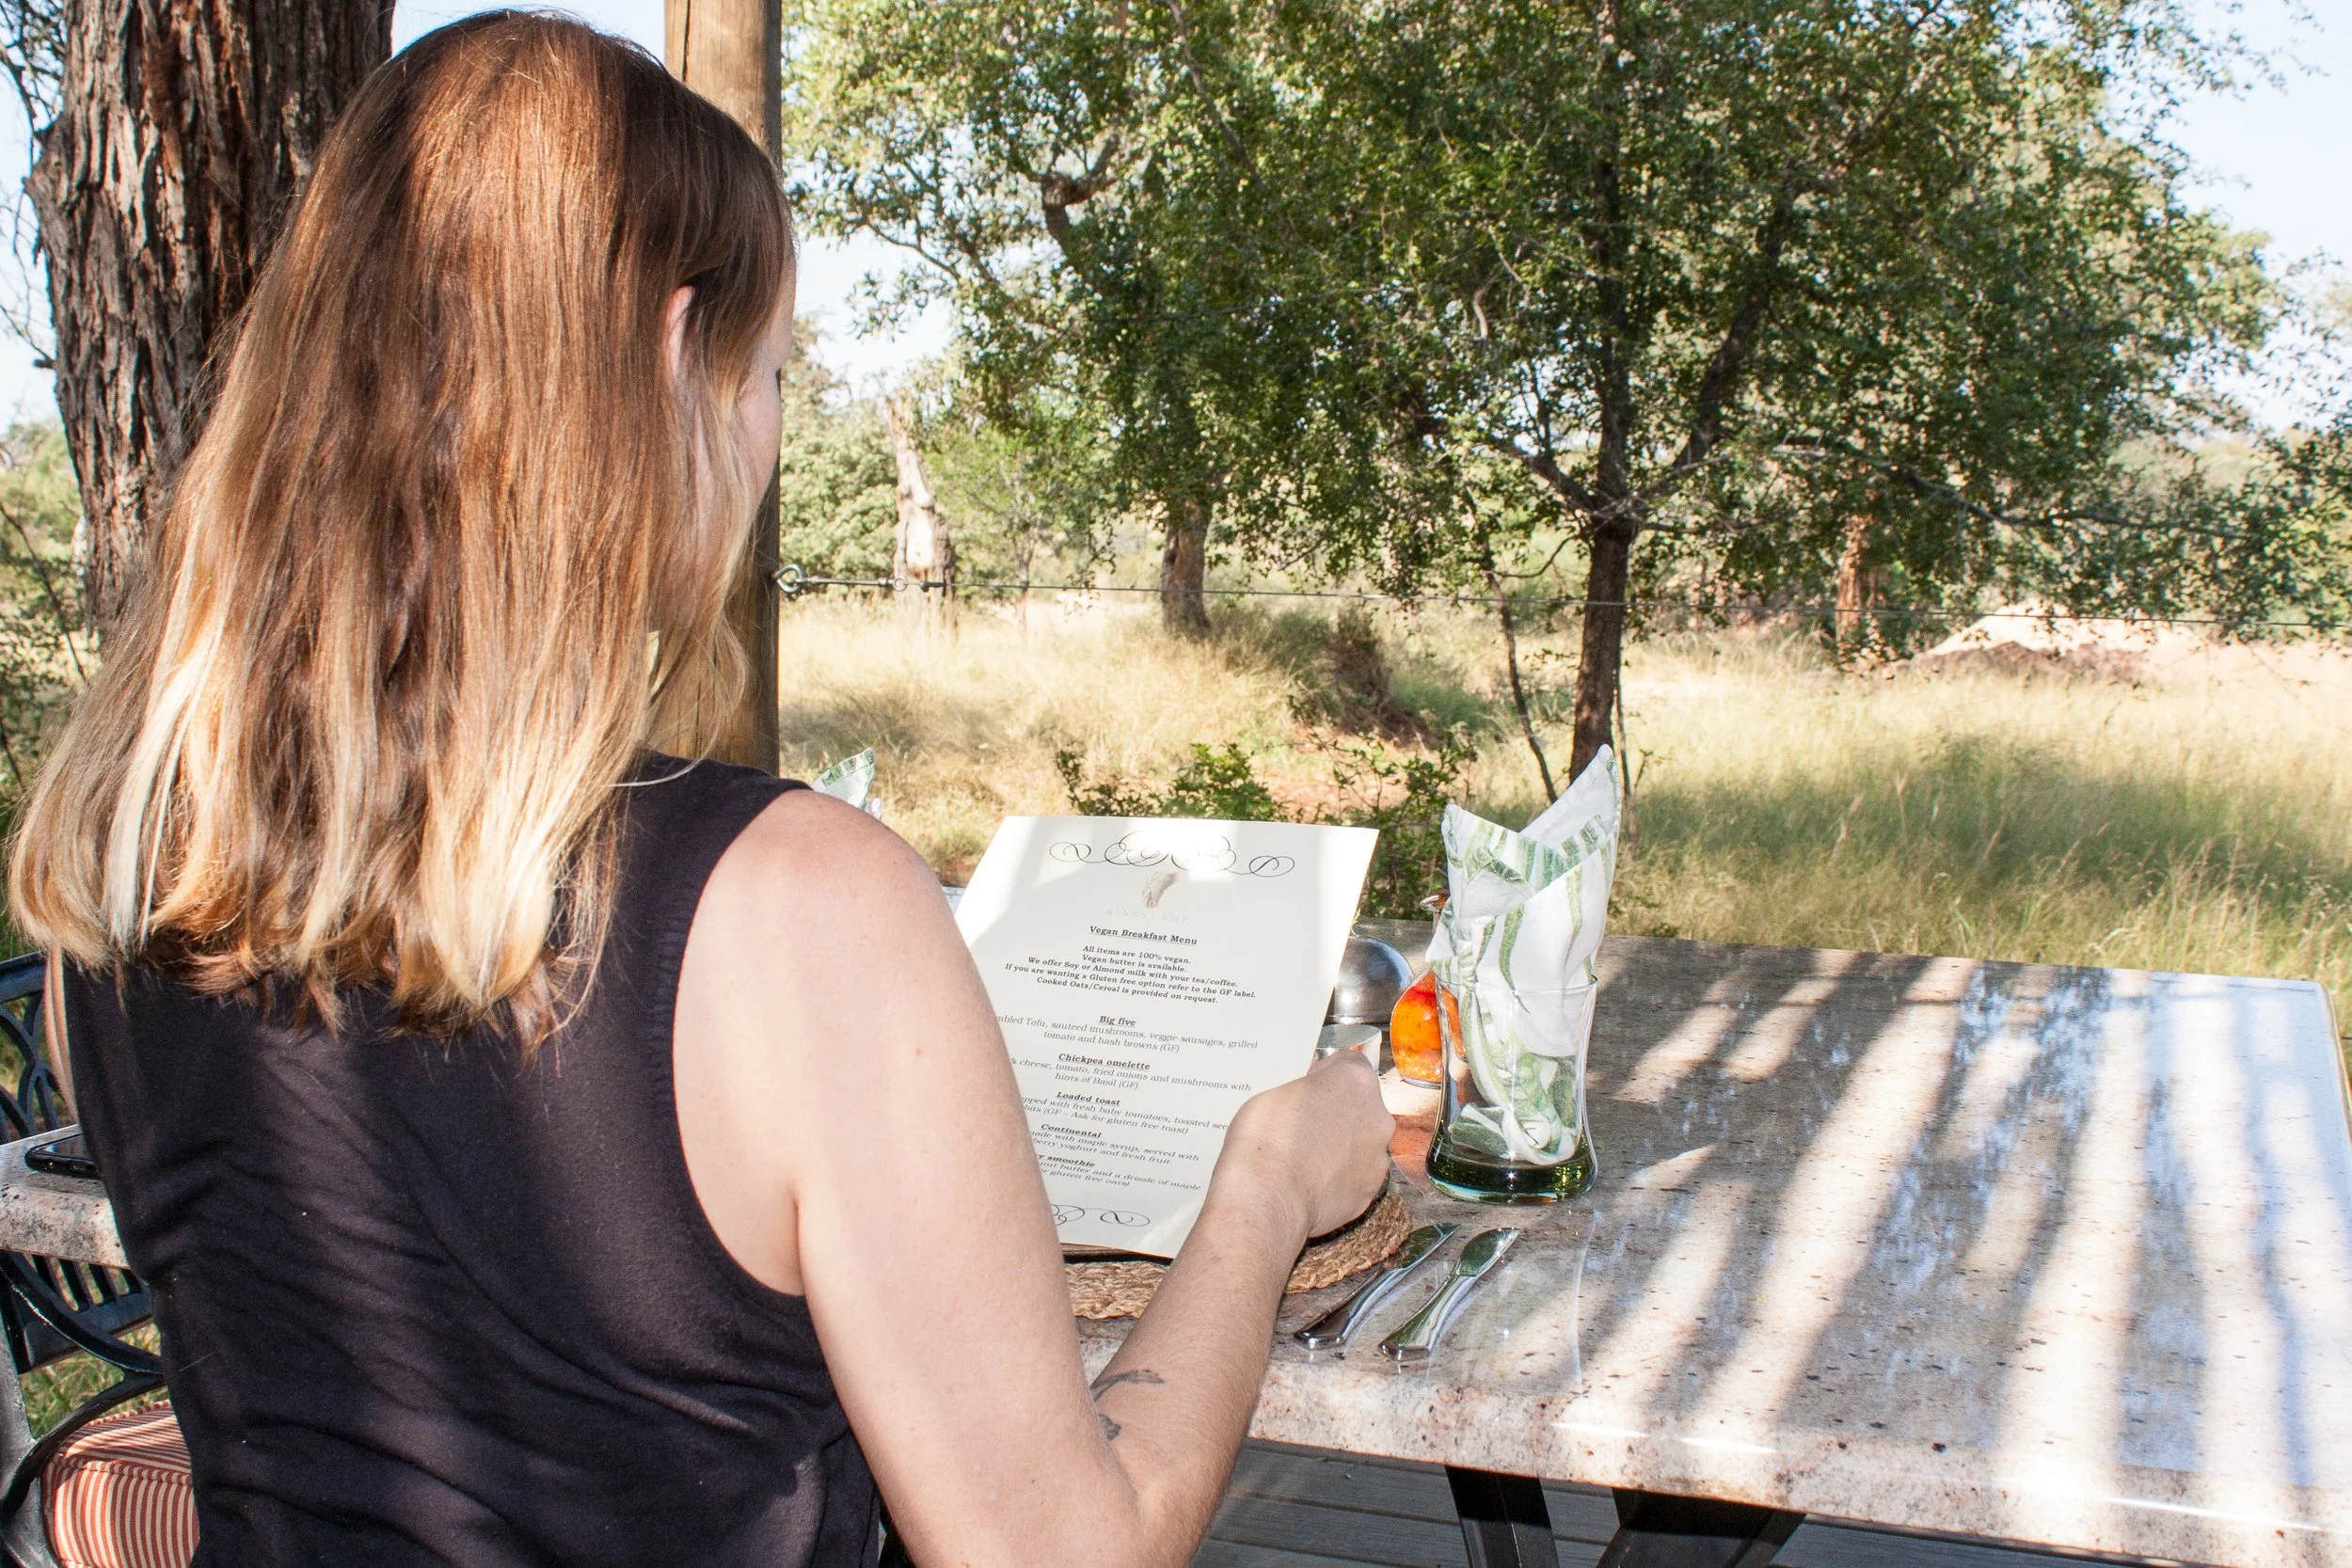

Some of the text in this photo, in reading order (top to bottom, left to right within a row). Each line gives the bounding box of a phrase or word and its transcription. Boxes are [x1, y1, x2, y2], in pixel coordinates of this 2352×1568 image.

[1090, 926, 1197, 944] Vegan Breakfast Menu
[1083, 955, 1106, 963] Vegan
[1148, 963, 1186, 972] available.
[1138, 952, 1162, 960] 100%
[1047, 969, 1080, 979] wanting
[1089, 974, 1117, 982] Gluten
[1064, 961, 1079, 970] Soy
[1093, 965, 1124, 974] Almond
[1192, 977, 1238, 987] tea/coffee.
[1037, 977, 1067, 986] Cooked
[1070, 981, 1120, 992] Oats/Cereal
[1132, 989, 1168, 997] provided
[1099, 1016, 1136, 1026] Big five
[998, 1015, 1258, 1049] mbled Tofu, sauteed mushrooms, veggie sausages, grilled
[1044, 1031, 1074, 1041] tomato
[1099, 1037, 1120, 1046] hash
[1124, 1039, 1157, 1050] browns
[1160, 1043, 1180, 1053] (GF)
[1058, 1053, 1150, 1070] Chickpea omelette
[1020, 1059, 1052, 1069] cheese,
[1056, 1064, 1089, 1073] tomato,
[1117, 1071, 1148, 1080] onions
[1171, 1076, 1228, 1089] mushrooms
[1056, 1073, 1078, 1082] hints
[1093, 1078, 1117, 1086] Basil
[1119, 1081, 1138, 1090] (GF)
[1057, 1092, 1120, 1105] Loaded toast
[1072, 1112, 1089, 1120] Ask
[1106, 1117, 1137, 1127] gluten
[1162, 1126, 1188, 1134] toast)
[1073, 1102, 1096, 1112] fresh
[1100, 1107, 1122, 1116] baby
[1125, 1111, 1170, 1123] tomatoes,
[1174, 1117, 1210, 1128] toasted
[1041, 1124, 1102, 1138] Continental
[1061, 1144, 1097, 1152] yoghurt
[1110, 1143, 1139, 1152] syrup,
[1144, 1148, 1175, 1157] served
[1047, 1155, 1095, 1167] smoothie
[1050, 1170, 1081, 1179] gluten
[1060, 1164, 1089, 1173] butter
[1170, 1181, 1200, 1190] maple
